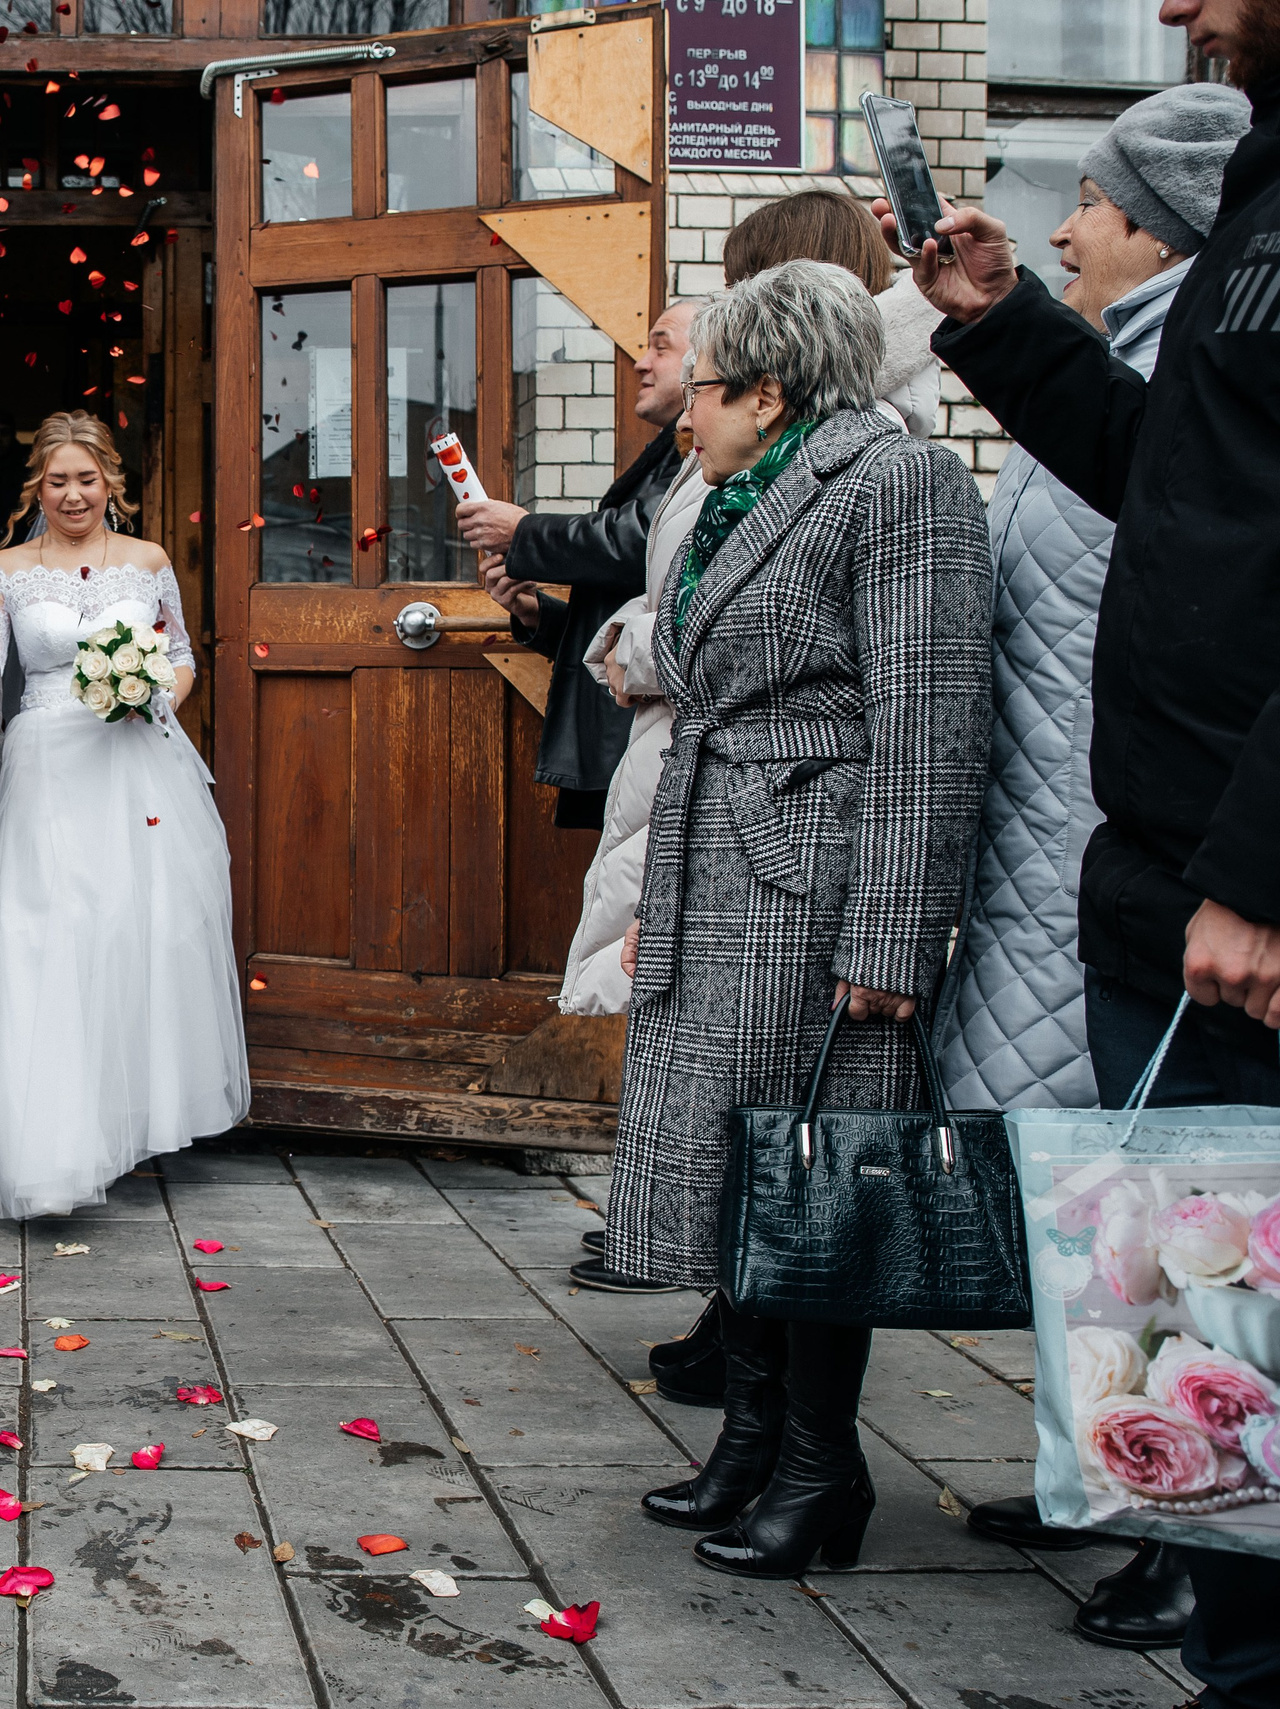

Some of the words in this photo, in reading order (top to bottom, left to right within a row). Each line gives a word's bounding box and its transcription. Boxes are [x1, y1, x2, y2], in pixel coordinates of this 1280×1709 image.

[686, 48, 747, 60] ПЕРЕРЫВ
[718, 75, 739, 91] до
[686, 99, 749, 112] ВЫХОДНЫЕ
[669, 121, 742, 135] АНИТАРНЫЙ
[744, 124, 776, 136] ДЕНЬ
[669, 133, 728, 147] ОСЛЕДНИЙ
[730, 136, 781, 148] ЧЕТВЕРГ
[724, 149, 773, 162] МЕСЯЦА
